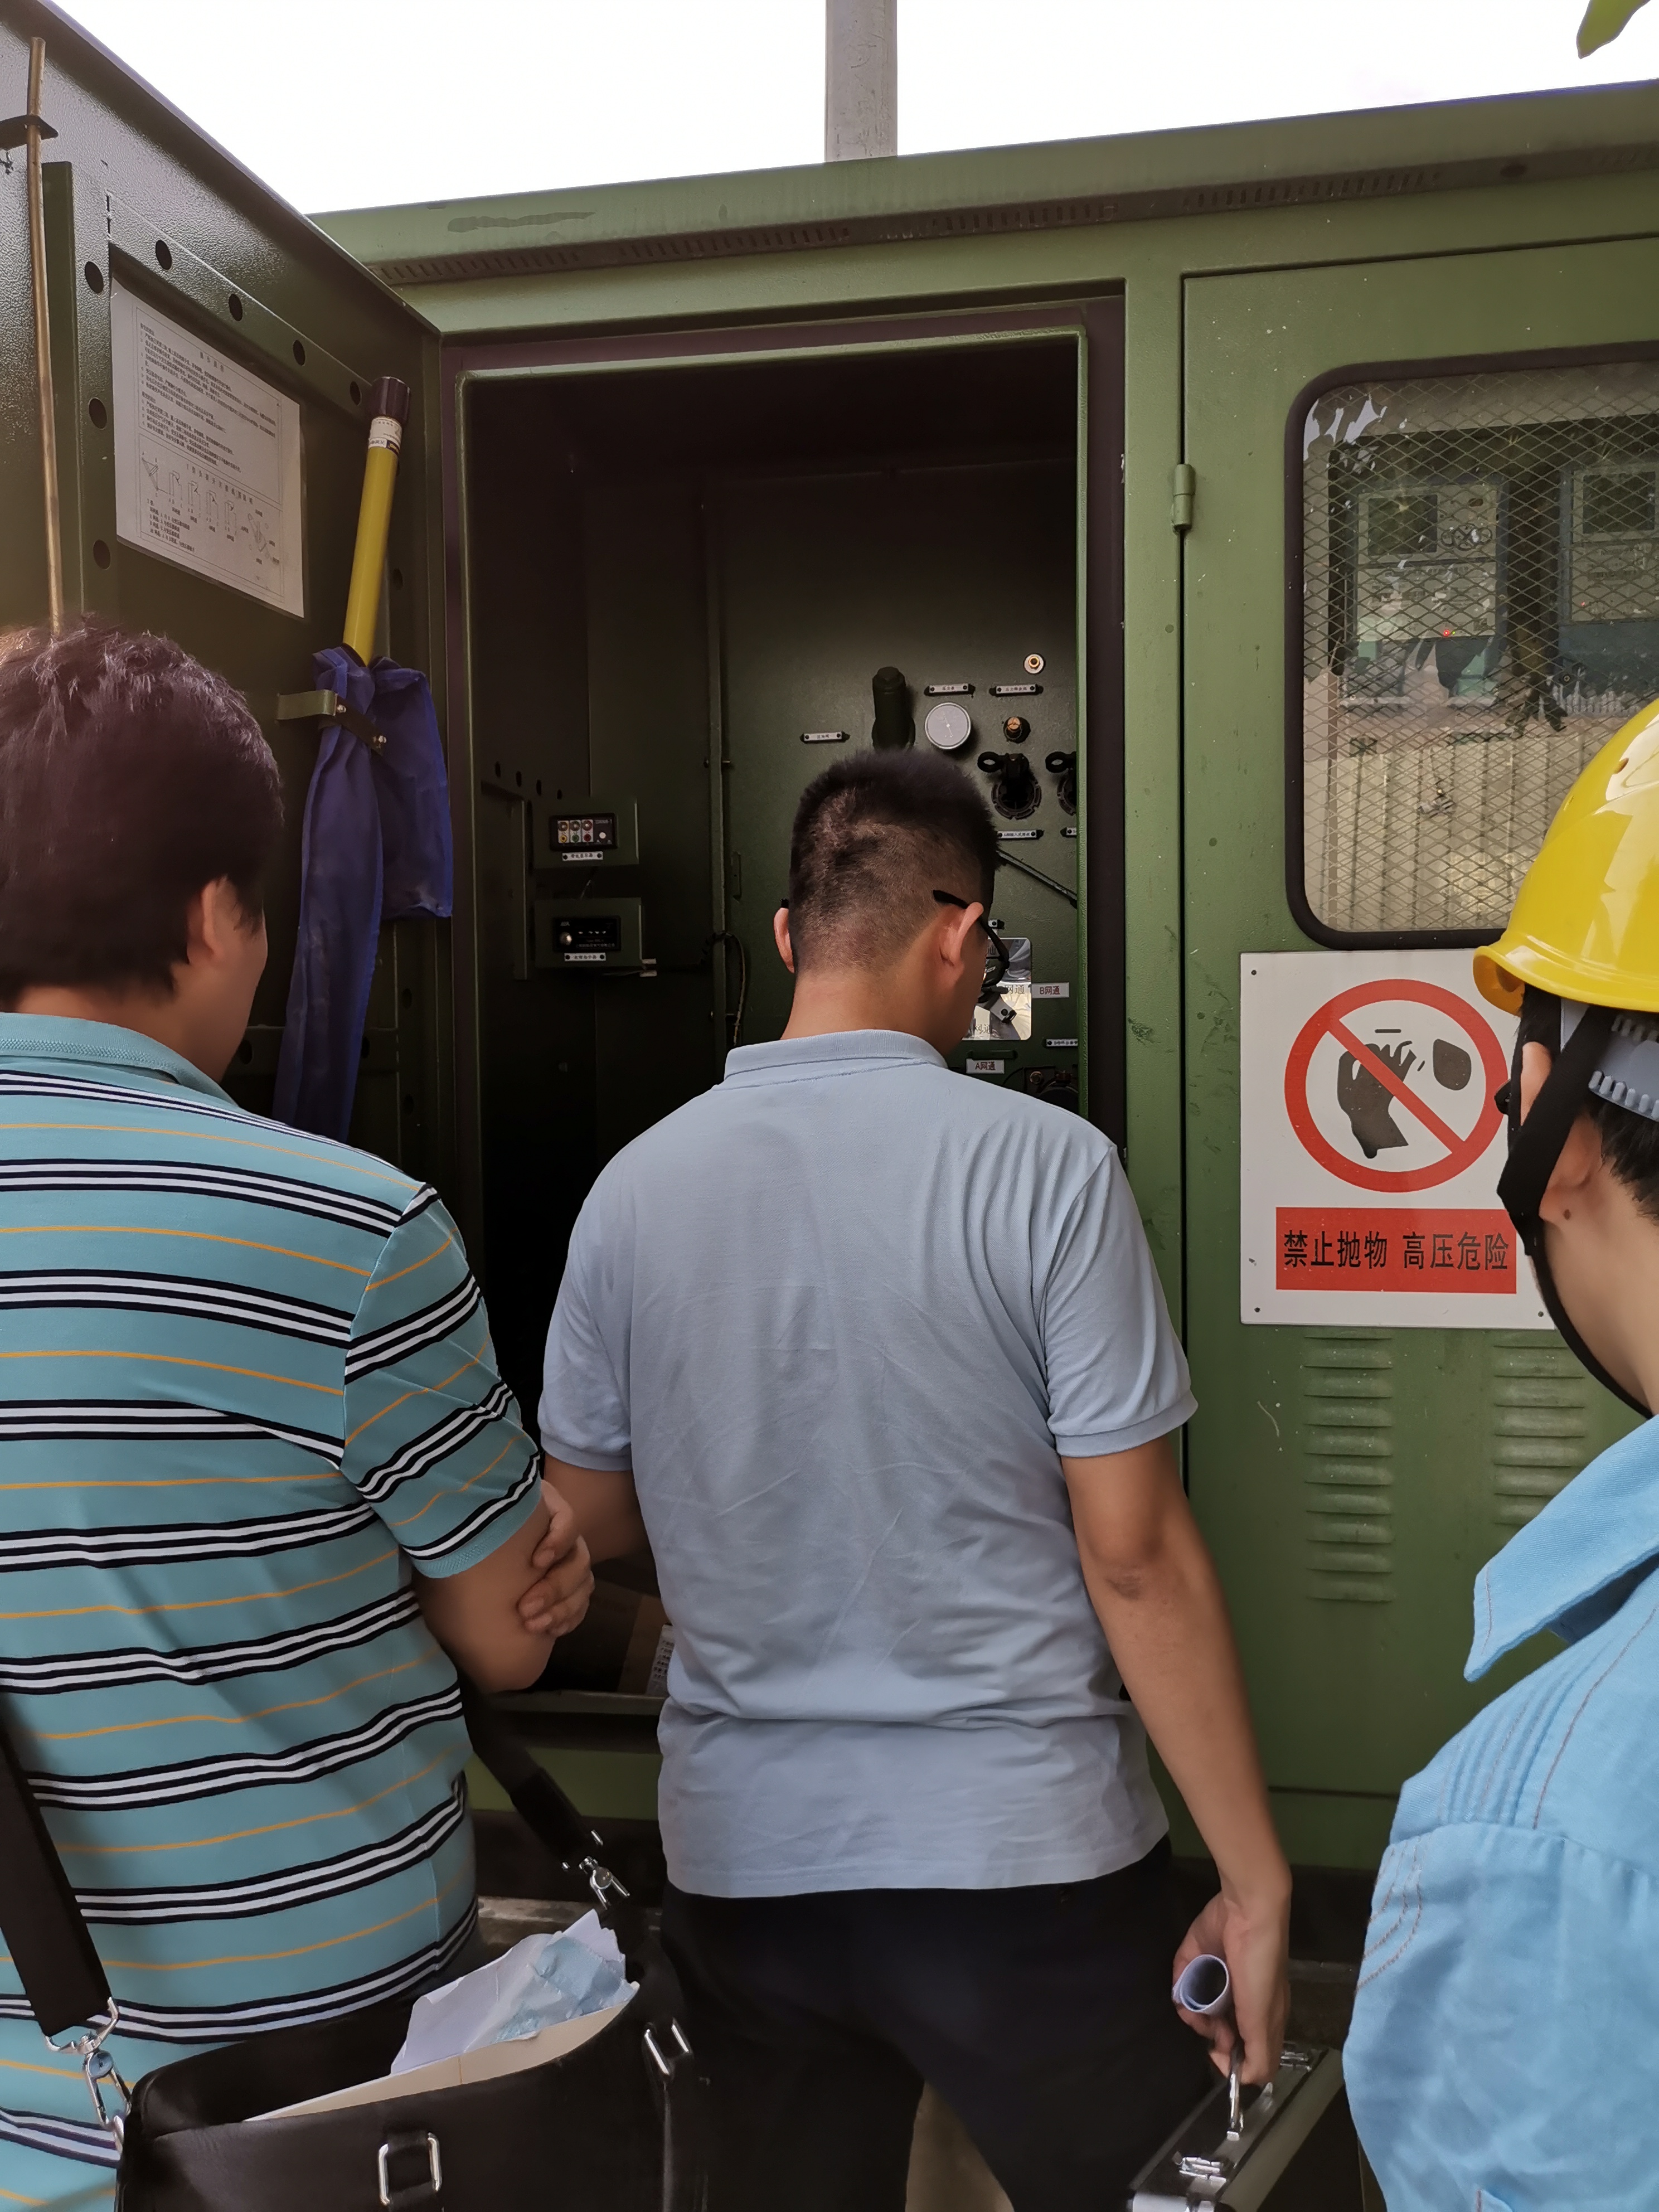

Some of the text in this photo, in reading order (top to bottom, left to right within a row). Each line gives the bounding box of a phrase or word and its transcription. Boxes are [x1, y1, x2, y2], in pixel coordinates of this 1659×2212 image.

[1039, 985, 1060, 995] B网通
[975, 1061, 996, 1070] A网通
[1283, 1229, 1508, 1270] 禁止抛物 高压危险
